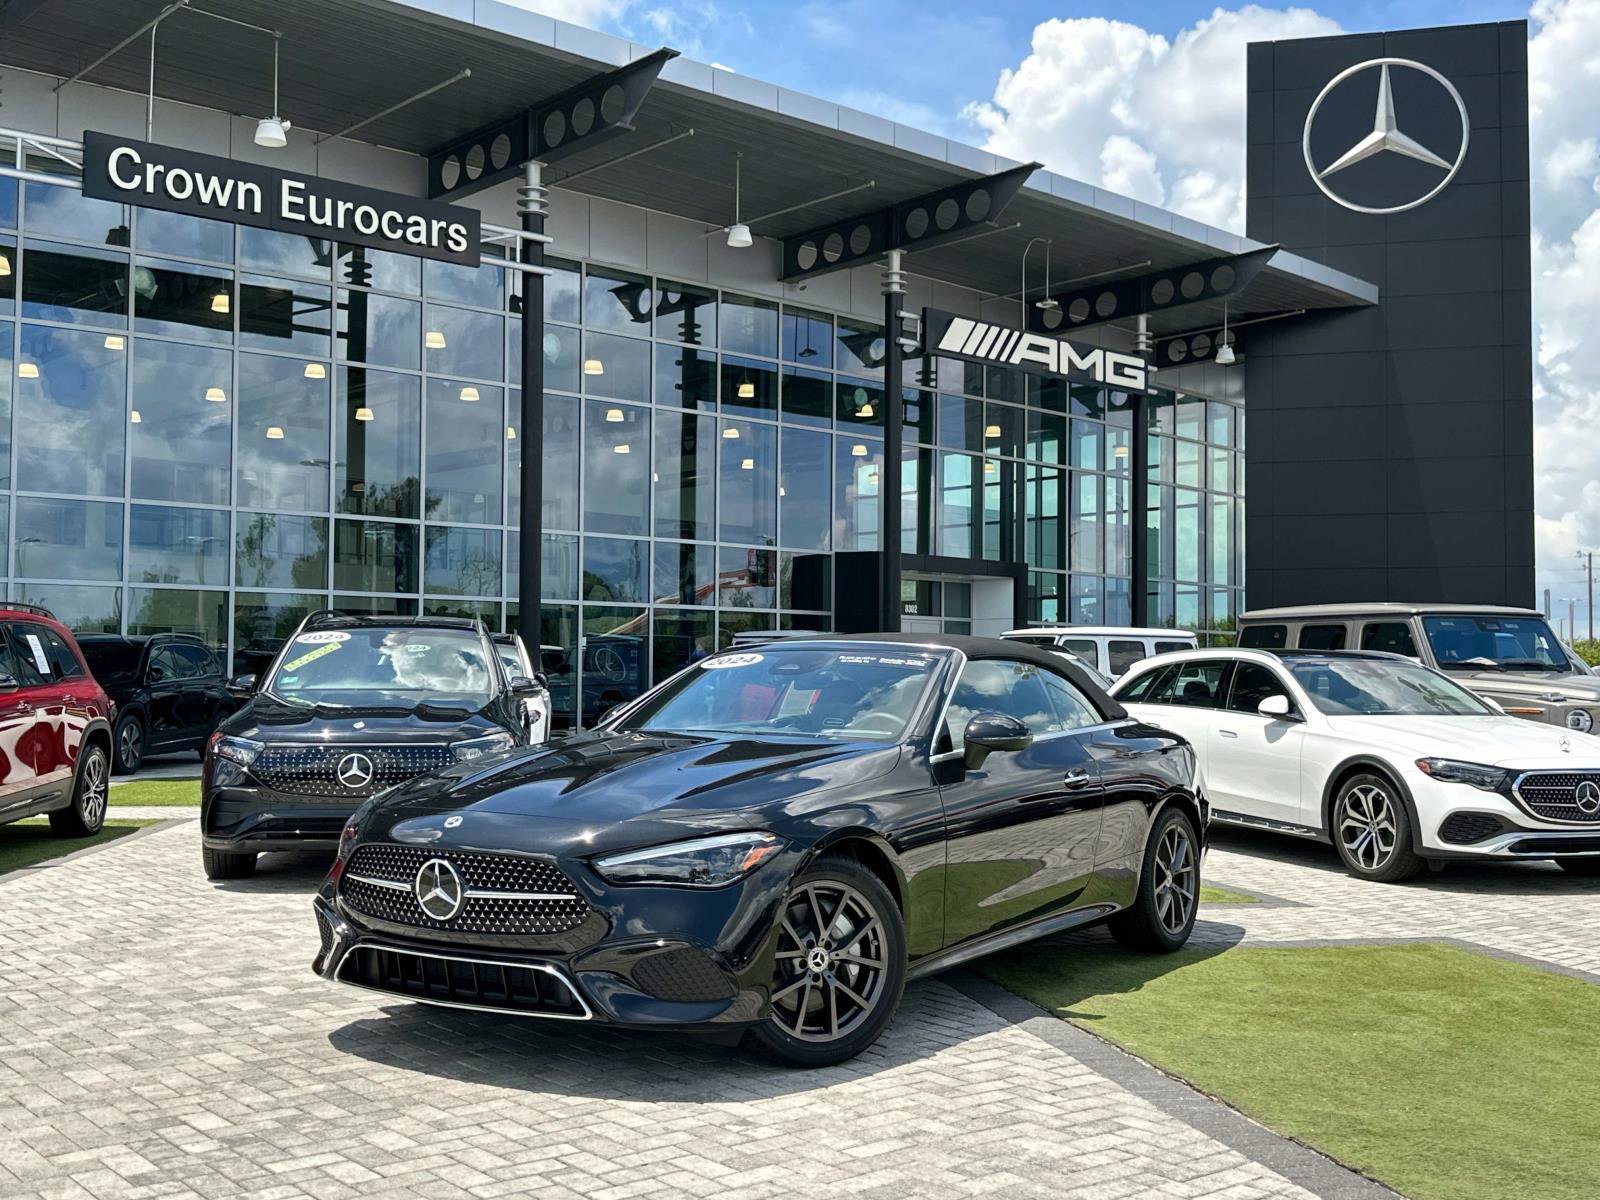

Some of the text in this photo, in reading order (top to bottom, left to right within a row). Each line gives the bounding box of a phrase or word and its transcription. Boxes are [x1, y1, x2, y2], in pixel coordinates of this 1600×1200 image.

[107, 146, 469, 253] Crown Eurocars
[1008, 332, 1146, 391] AMG
[904, 604, 918, 614] 8302
[302, 633, 345, 642] 2024
[707, 655, 757, 666] 2024
